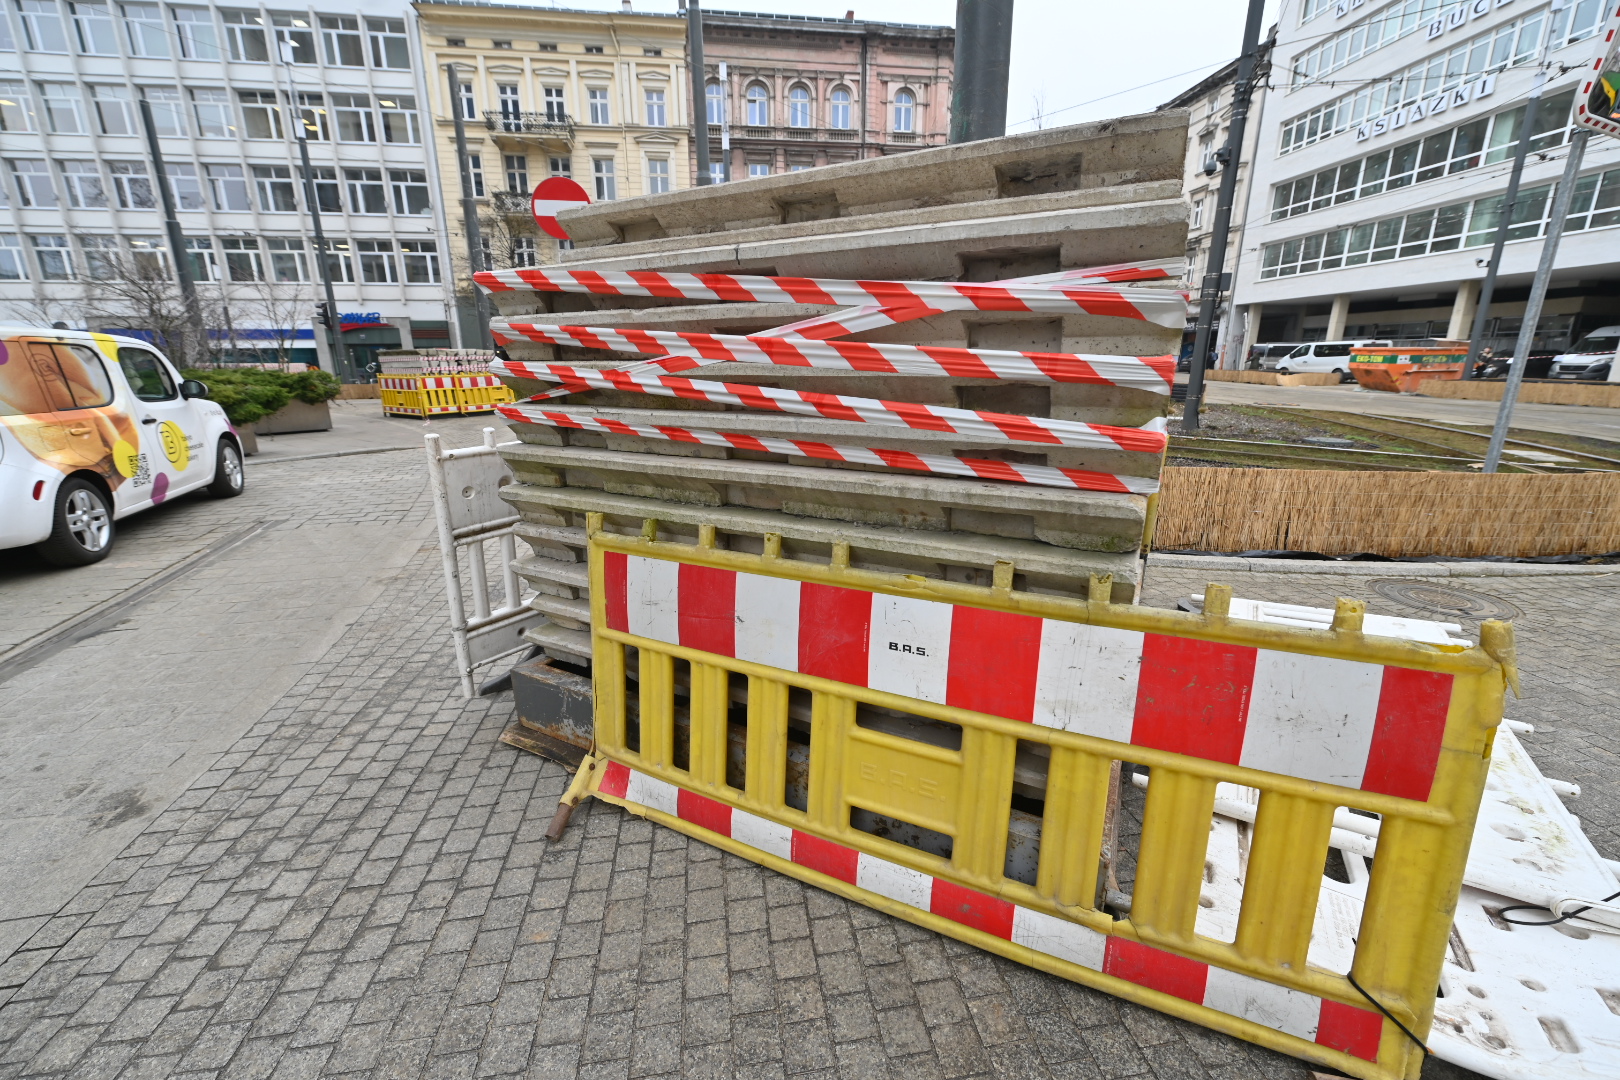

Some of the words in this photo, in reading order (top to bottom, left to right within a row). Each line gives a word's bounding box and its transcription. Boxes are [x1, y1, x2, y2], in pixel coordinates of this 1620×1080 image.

[1428, 0, 1504, 37] BUC
[1356, 79, 1487, 140] KSIAZKI
[889, 641, 929, 657] B.A.S.
